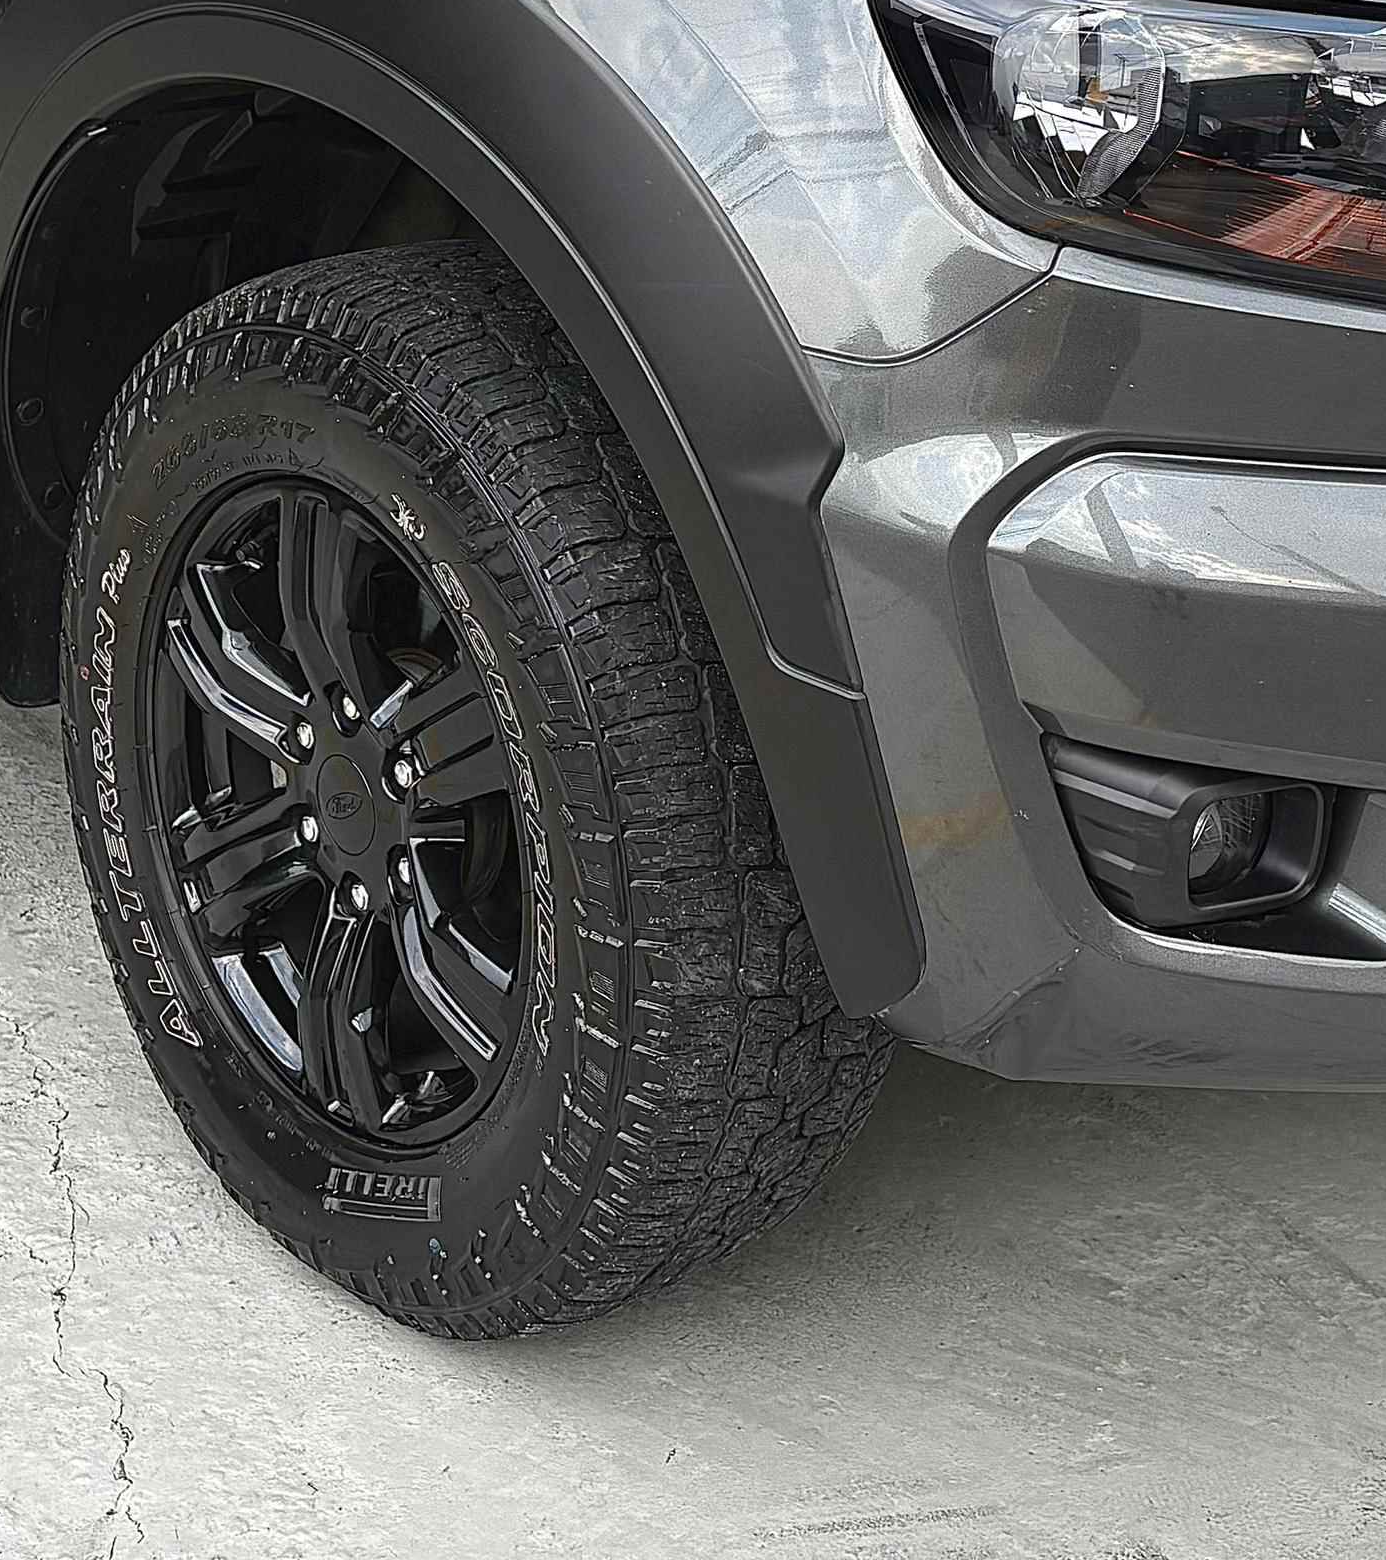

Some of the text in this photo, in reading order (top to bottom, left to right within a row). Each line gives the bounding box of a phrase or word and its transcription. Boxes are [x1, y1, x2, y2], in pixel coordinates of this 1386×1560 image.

[90, 547, 204, 1048] ALL TERRAIN Plus
[430, 560, 557, 1057] SCORPION
[324, 1167, 442, 1222] PIRELLI
